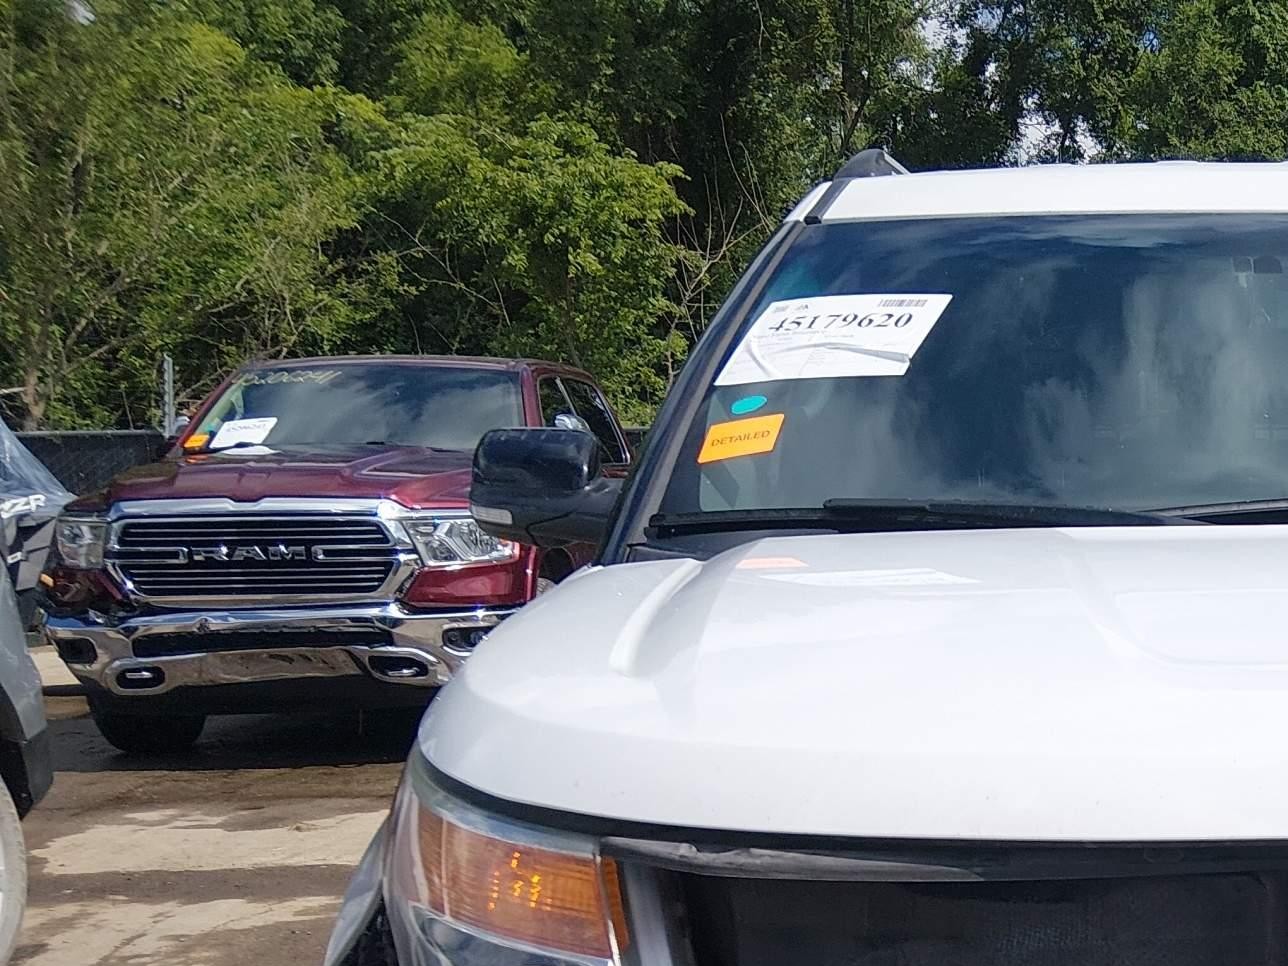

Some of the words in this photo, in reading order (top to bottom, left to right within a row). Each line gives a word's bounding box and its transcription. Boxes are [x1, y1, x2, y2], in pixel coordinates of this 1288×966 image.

[768, 312, 913, 332] 45179620
[711, 429, 771, 448] DETAILED
[191, 545, 307, 561] RAM
